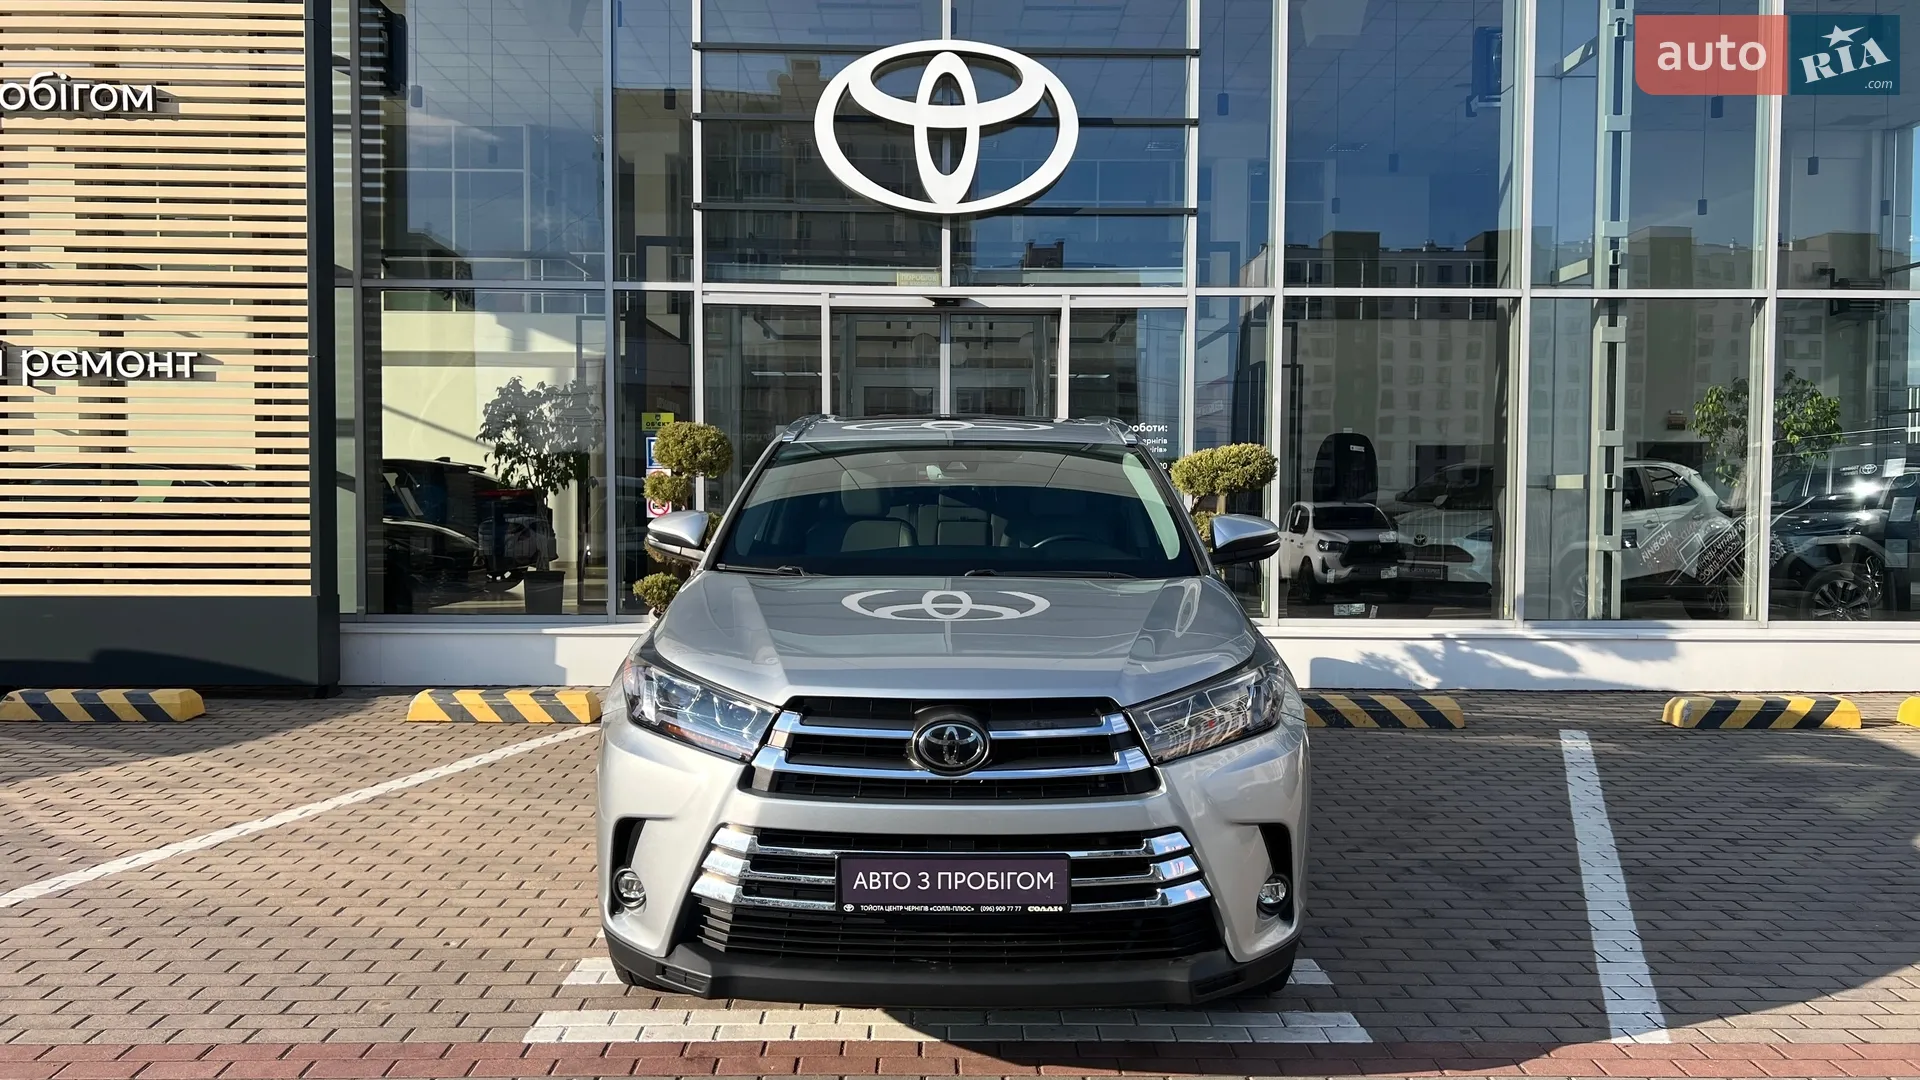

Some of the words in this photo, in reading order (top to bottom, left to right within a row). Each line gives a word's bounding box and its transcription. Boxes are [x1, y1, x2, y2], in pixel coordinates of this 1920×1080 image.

[21, 348, 199, 386] ремонт
[853, 871, 911, 890] АВТО
[917, 871, 930, 890] З
[937, 871, 1054, 890] ПРОБІГОМ
[860, 904, 884, 913] ТОЙОТА
[884, 905, 903, 913] ЦЕНТР
[904, 905, 929, 913] ЧЕРНІГІВ
[980, 905, 995, 913] (096)
[995, 905, 1006, 913] 909
[1006, 905, 1014, 913] 77
[1014, 905, 1022, 913] 77
